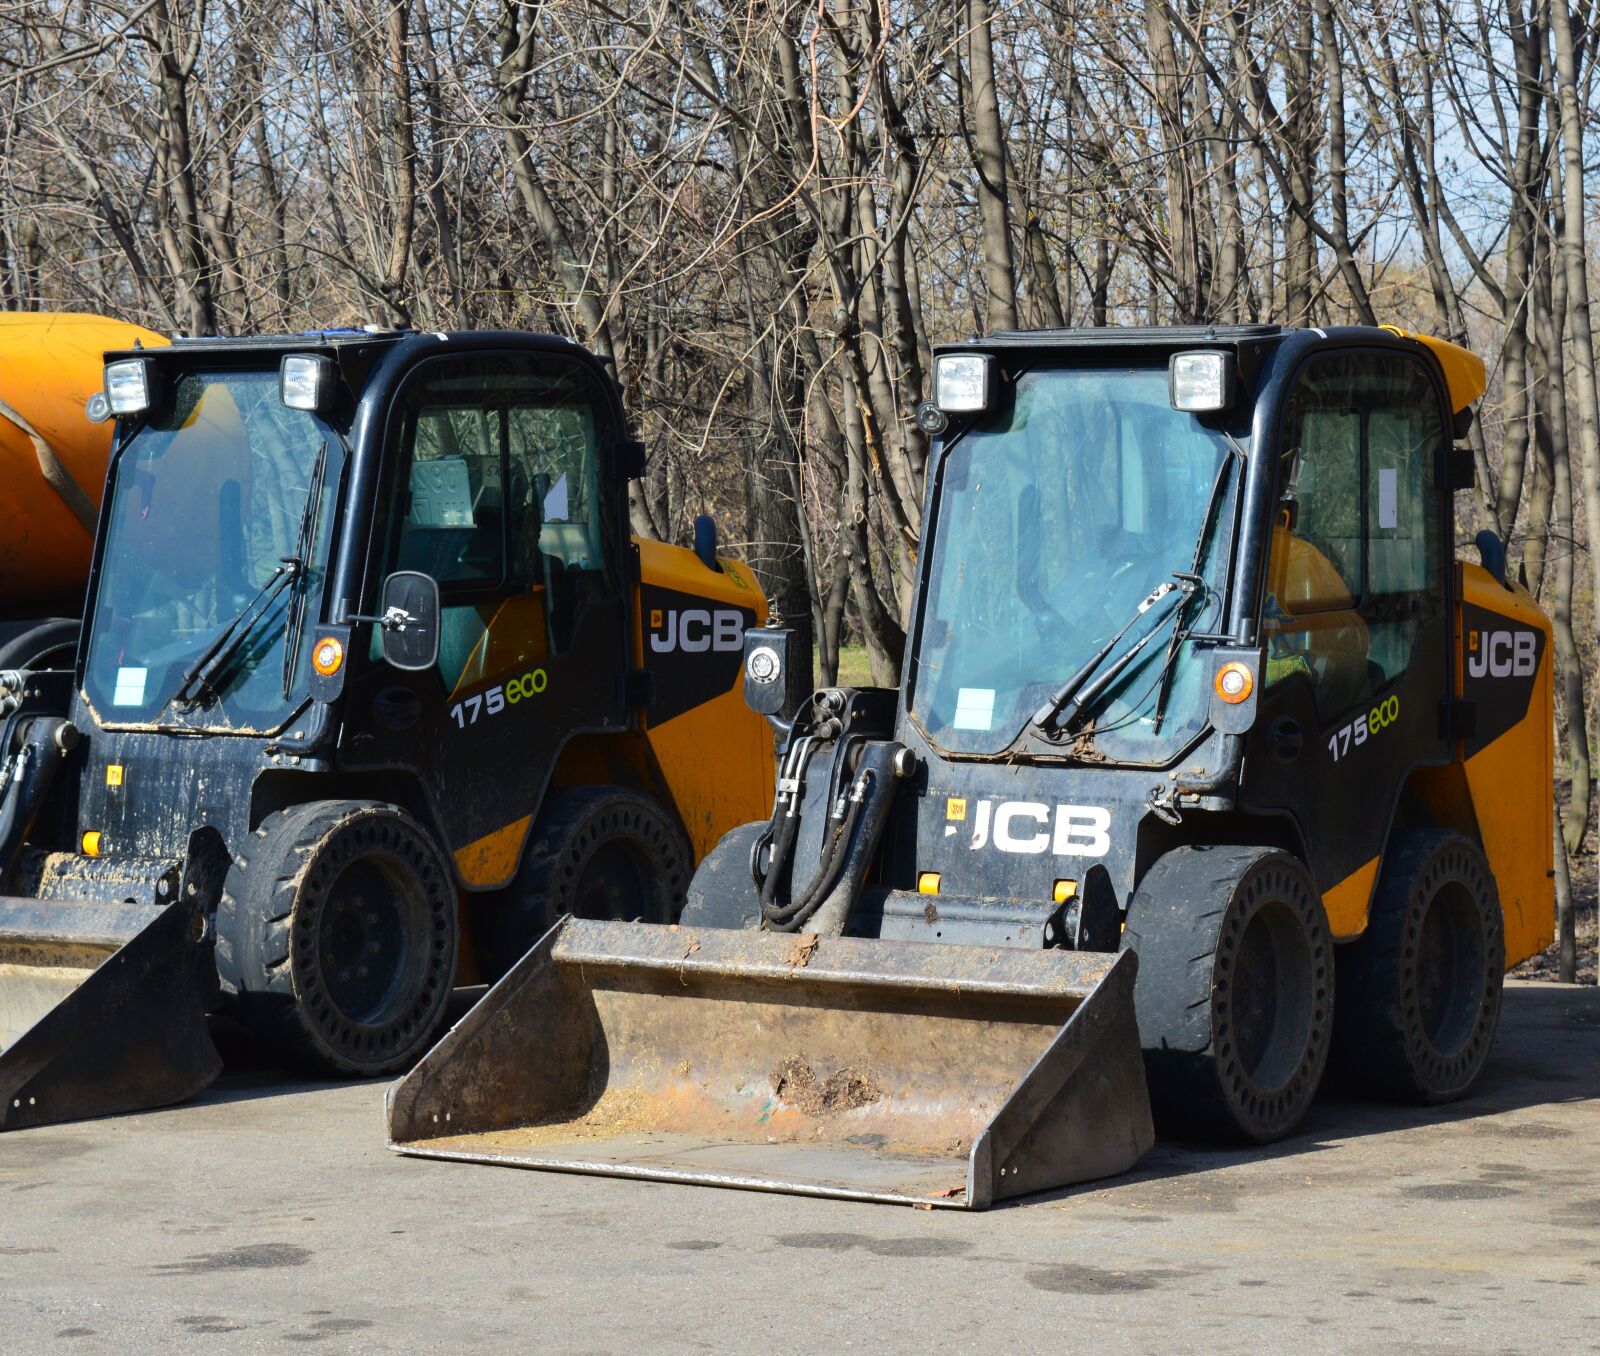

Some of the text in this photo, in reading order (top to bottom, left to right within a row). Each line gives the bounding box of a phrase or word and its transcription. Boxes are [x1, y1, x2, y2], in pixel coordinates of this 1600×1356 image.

[651, 609, 743, 652] JCB
[1468, 631, 1536, 677] JCB
[944, 799, 1111, 857] JCB
